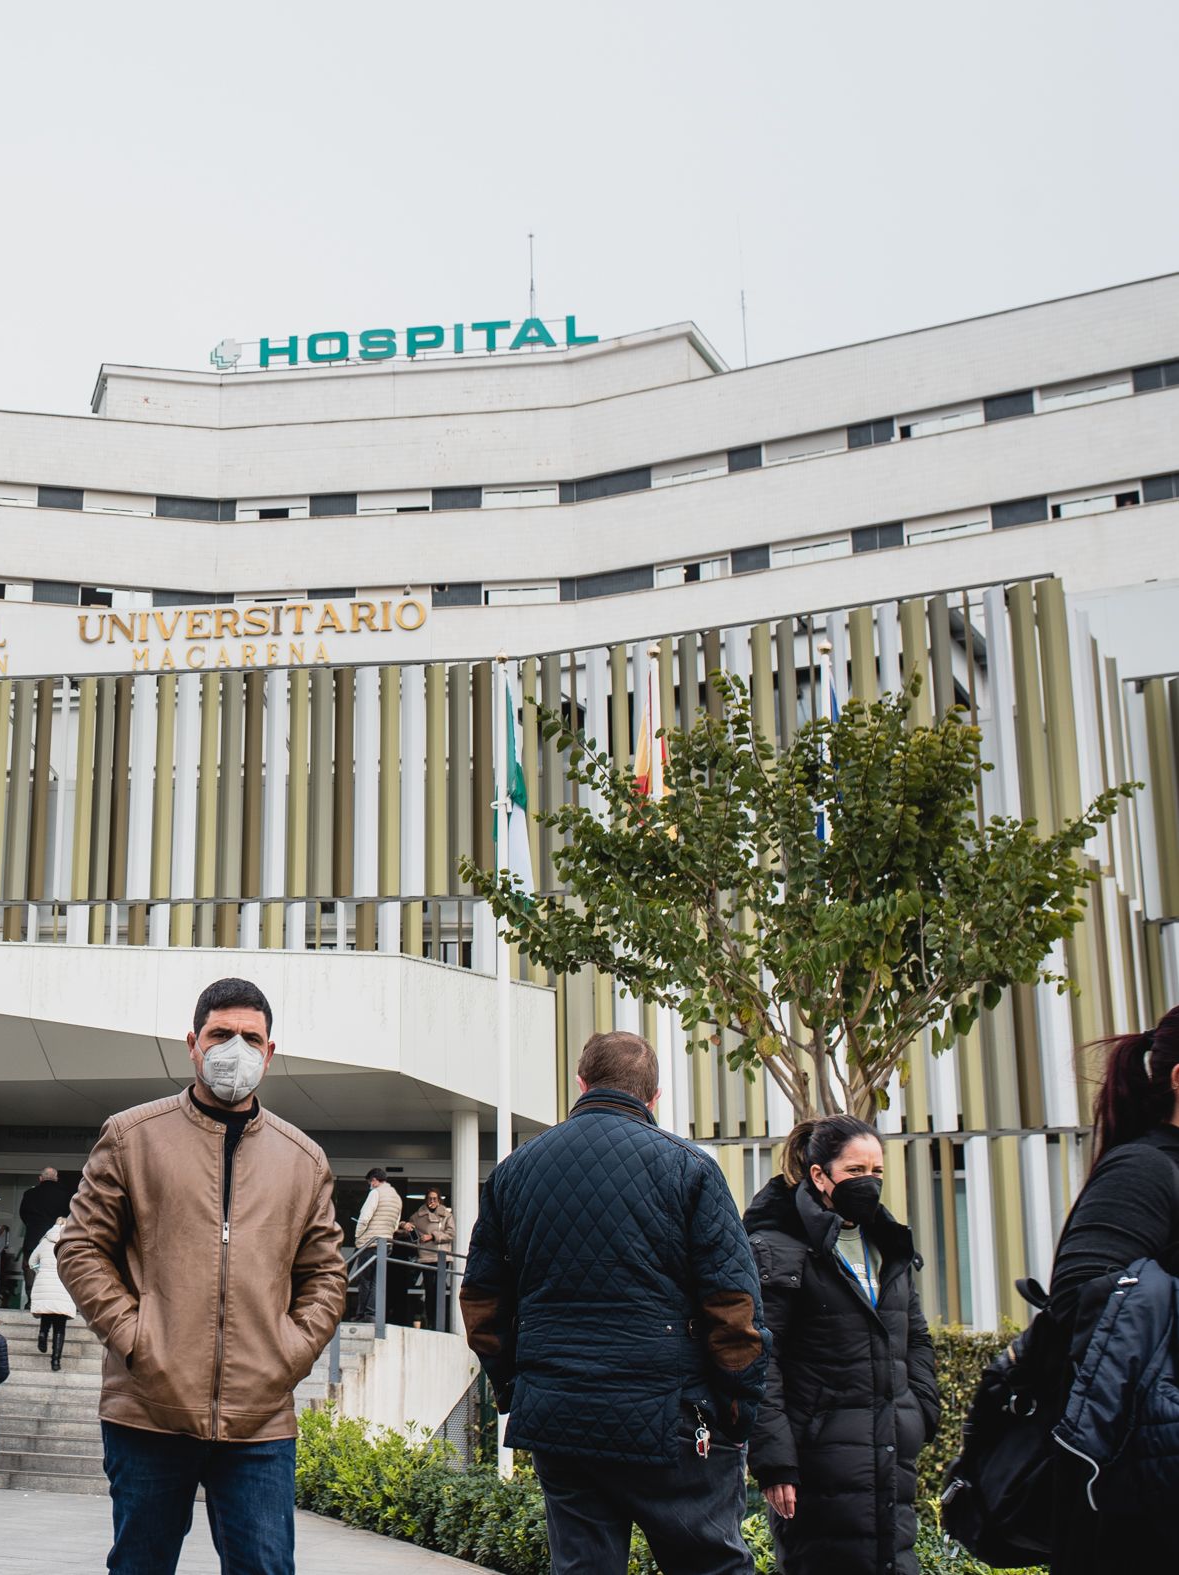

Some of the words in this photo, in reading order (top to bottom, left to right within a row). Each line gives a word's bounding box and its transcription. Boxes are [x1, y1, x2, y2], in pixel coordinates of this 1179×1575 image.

[260, 315, 599, 367] HOSPITAL
[78, 600, 426, 644] UNIVERSITARIO
[132, 641, 331, 671] MACARENA
